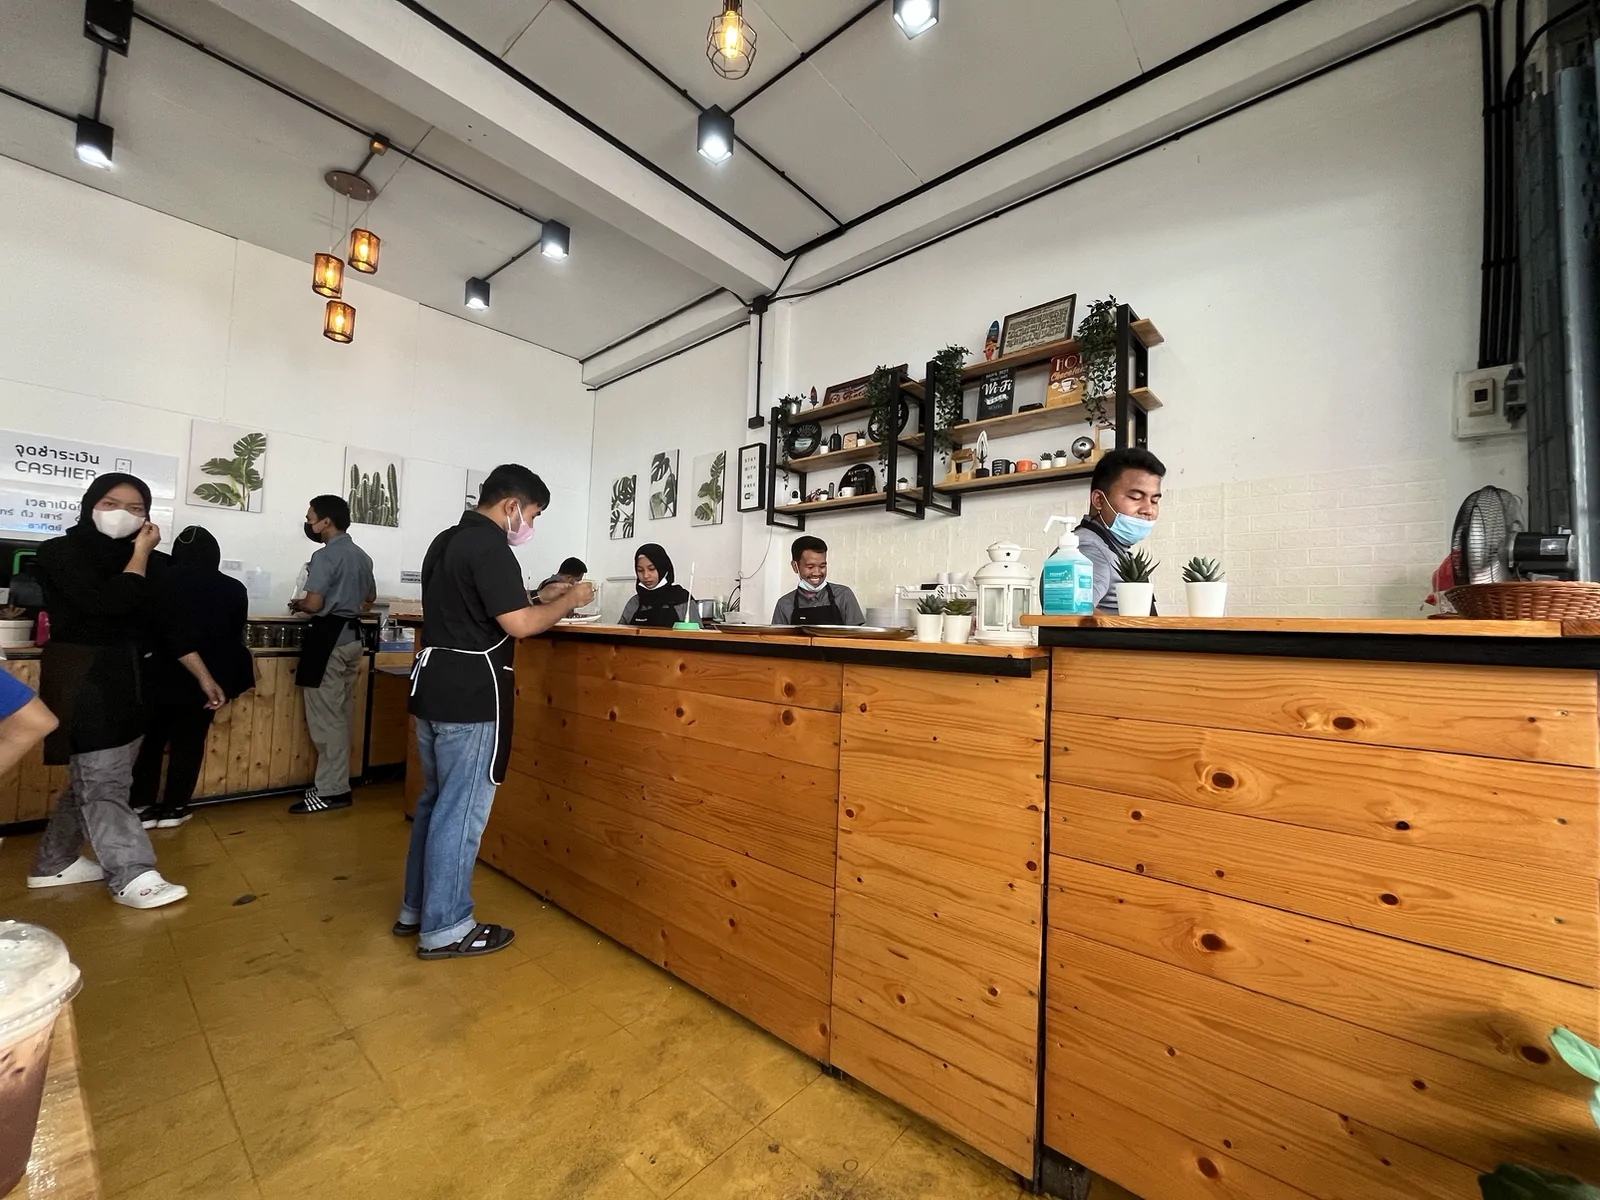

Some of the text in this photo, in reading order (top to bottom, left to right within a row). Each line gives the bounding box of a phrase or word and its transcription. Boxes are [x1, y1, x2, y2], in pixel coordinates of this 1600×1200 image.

[15, 444, 100, 465] จุดชำระเงิน
[15, 460, 97, 480] CASHIER
